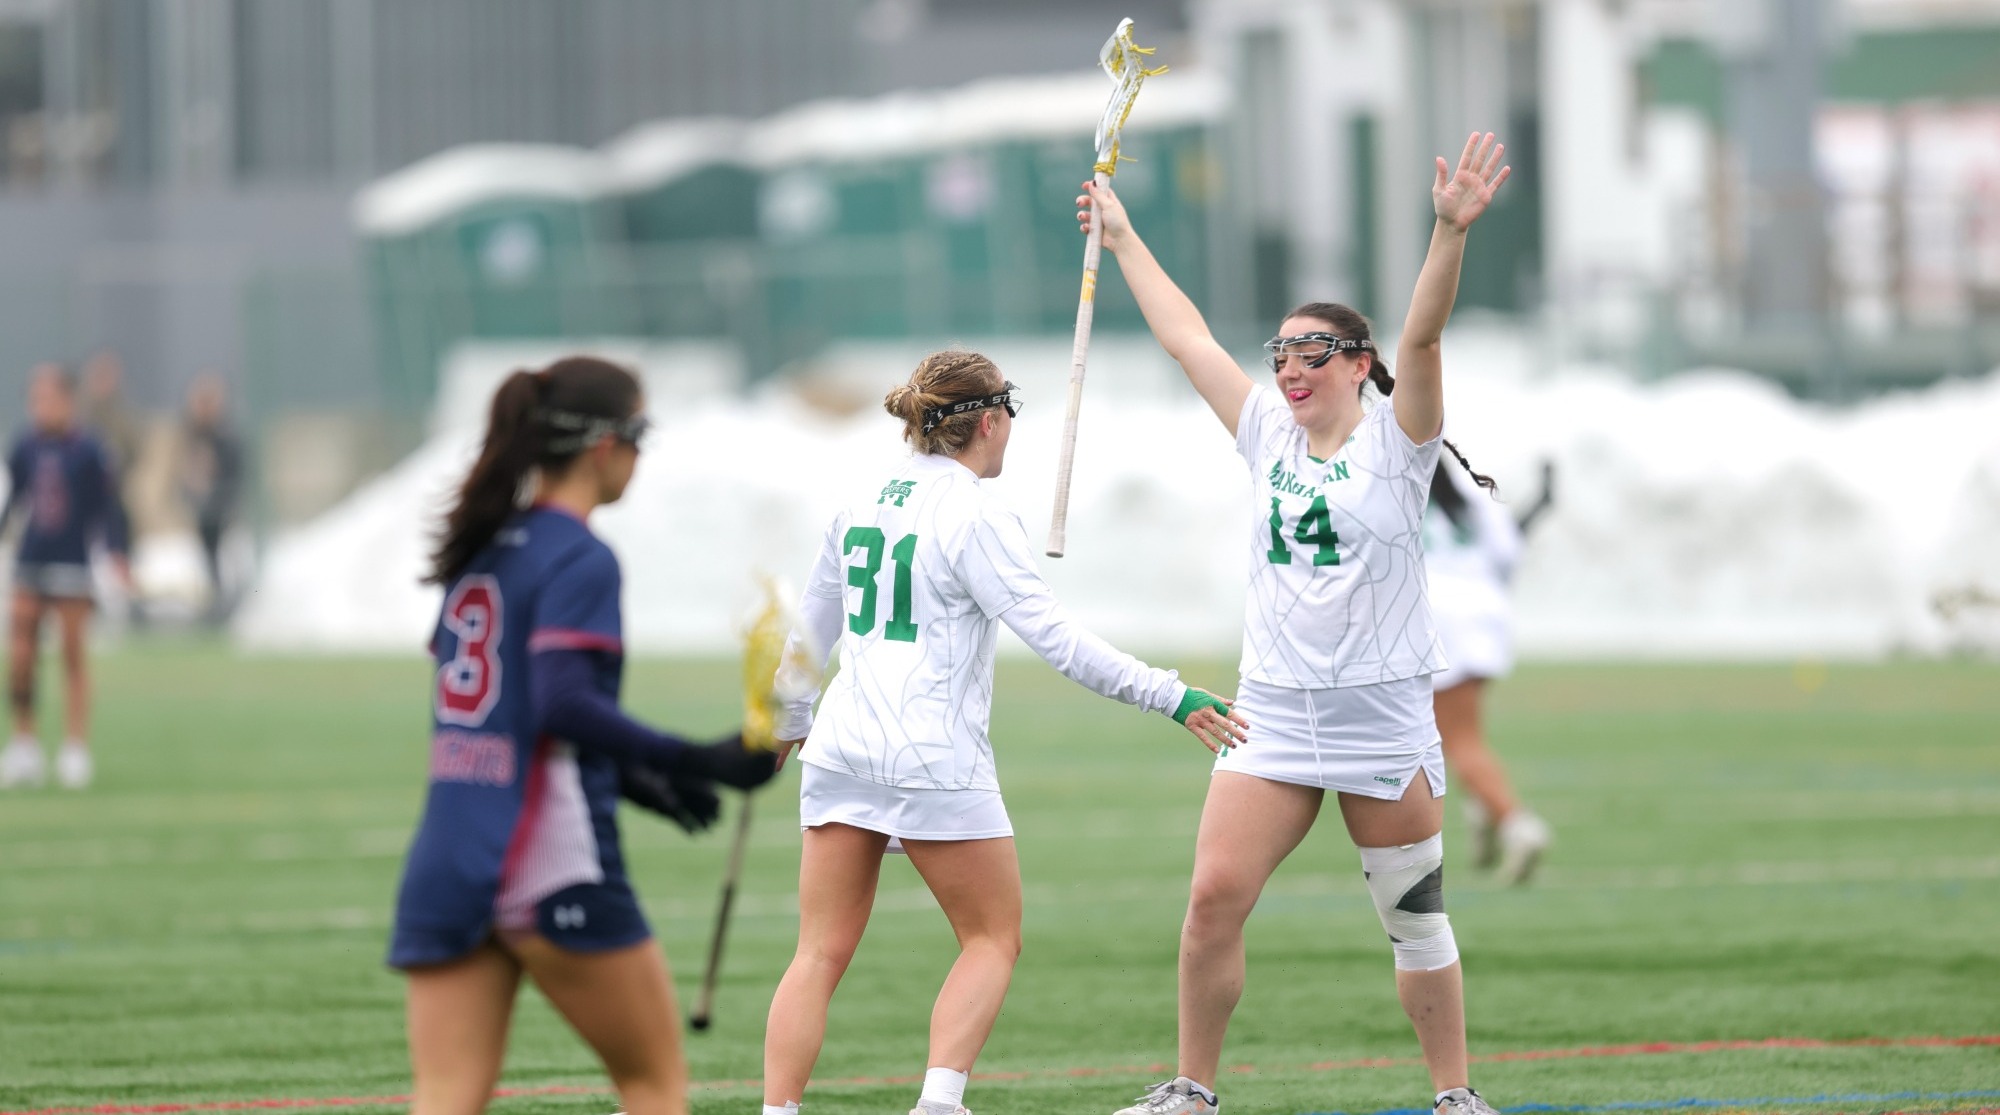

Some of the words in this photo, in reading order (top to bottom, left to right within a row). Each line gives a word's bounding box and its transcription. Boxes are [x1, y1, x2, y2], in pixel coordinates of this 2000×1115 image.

[1339, 339, 1357, 349] STX
[954, 399, 985, 413] STX
[992, 394, 1011, 405] ST
[1267, 495, 1341, 566] 14
[843, 526, 918, 643] 31
[434, 574, 503, 727] 3
[1374, 776, 1401, 786] capelli
